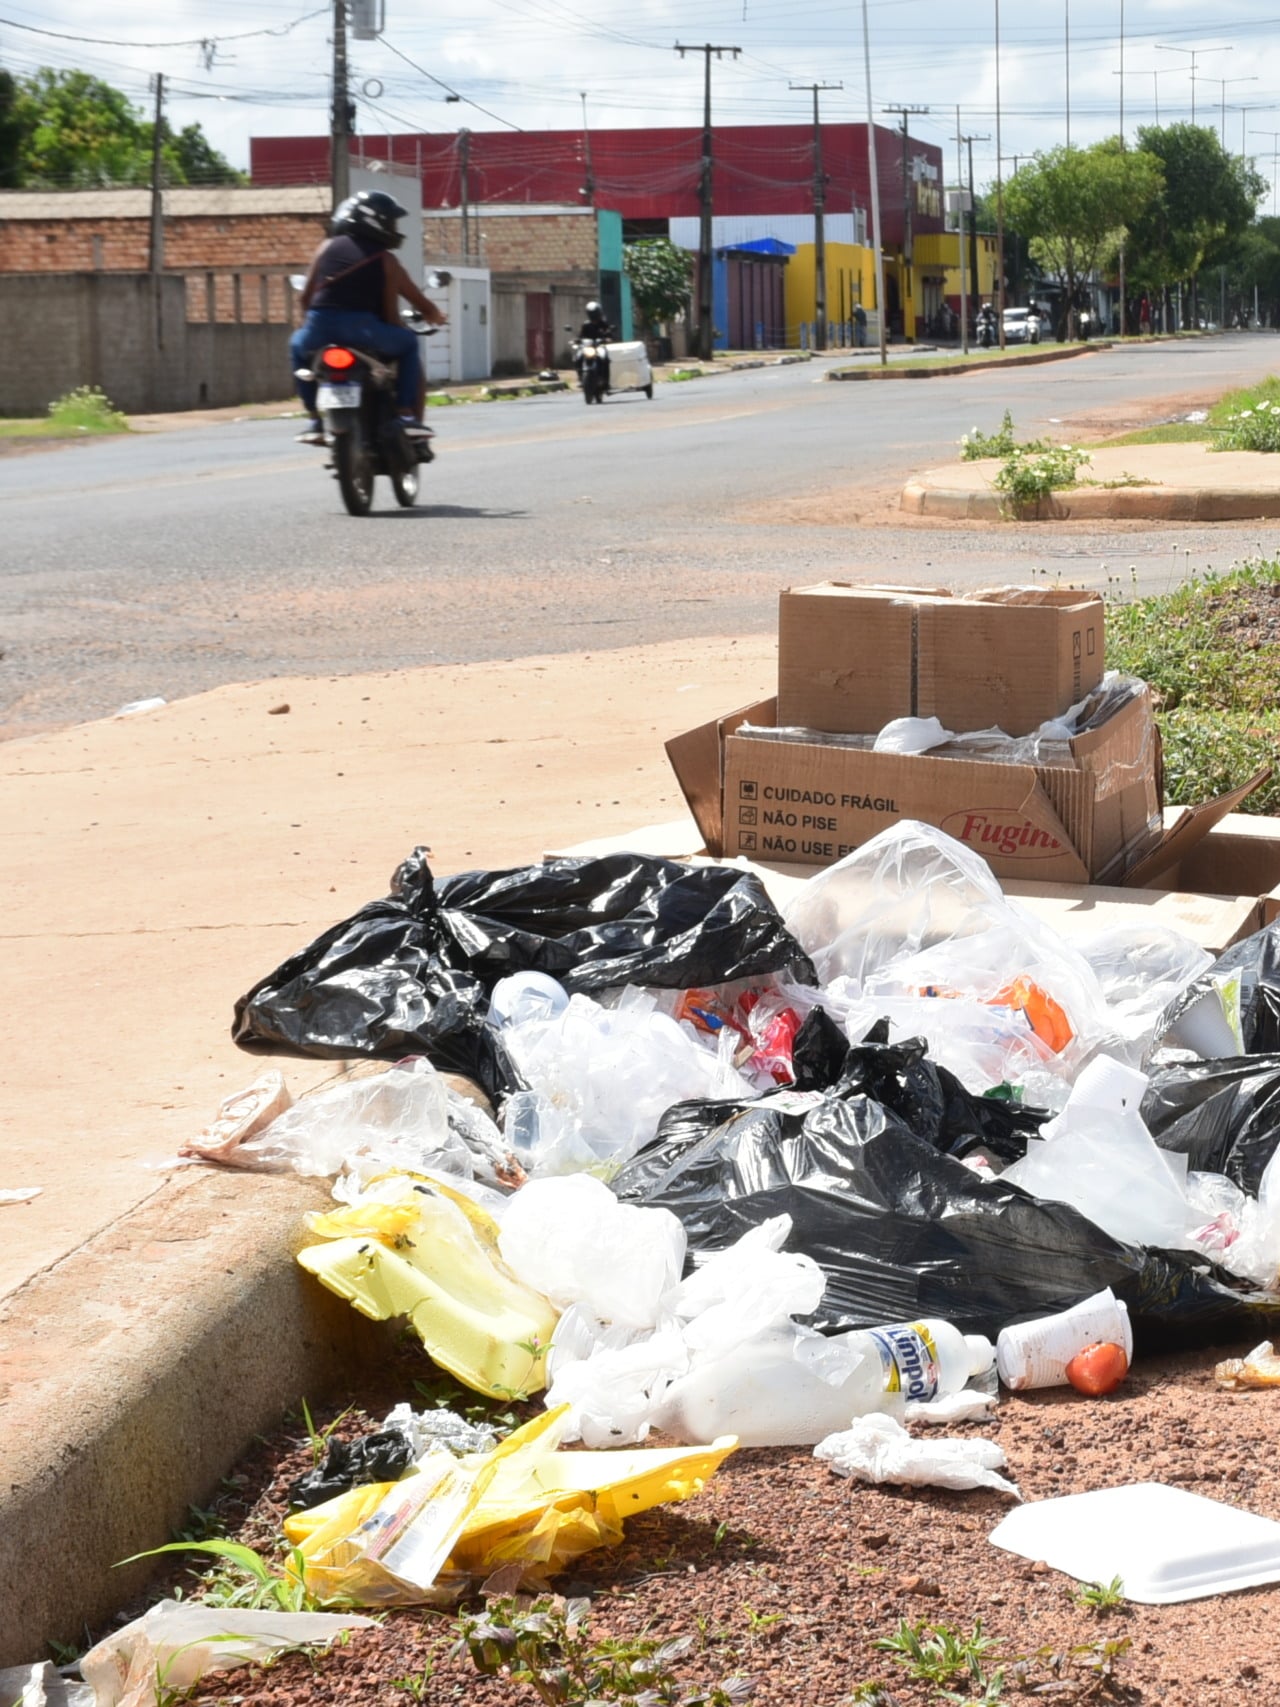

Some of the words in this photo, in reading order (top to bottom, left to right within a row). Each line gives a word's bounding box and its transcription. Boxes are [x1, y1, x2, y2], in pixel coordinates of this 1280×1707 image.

[763, 786, 836, 806] CUIDADO
[841, 794, 900, 813] FRÁGIL
[763, 810, 797, 827] NÃO
[802, 815, 837, 831] PISE
[762, 835, 797, 852] NÃO
[801, 840, 833, 857] USE
[886, 1329, 929, 1400] Limpol
